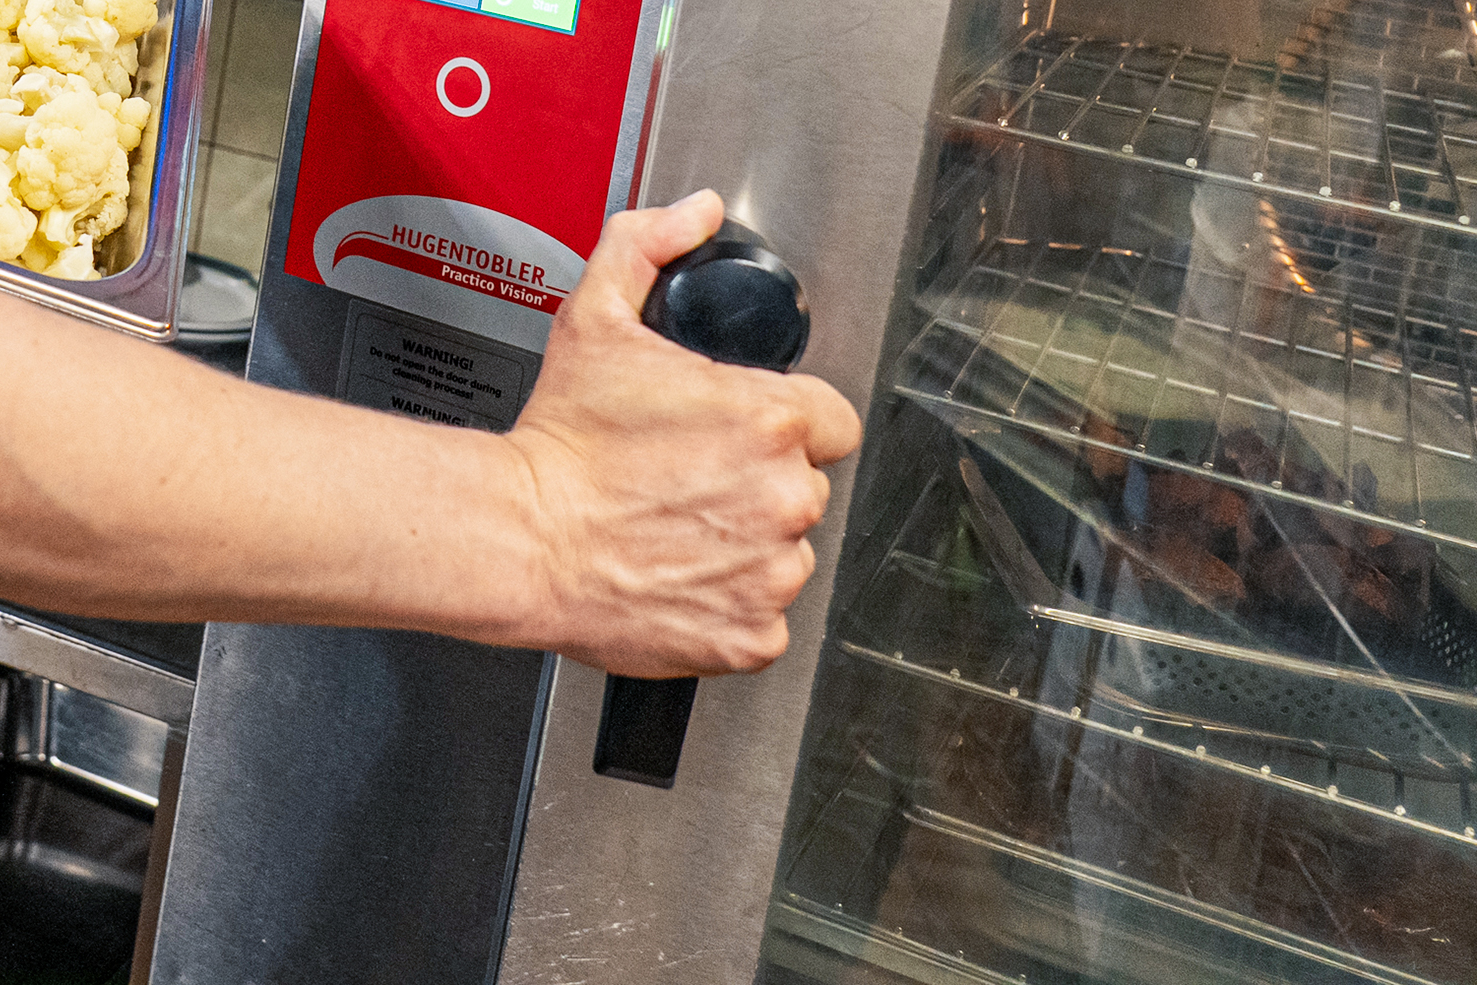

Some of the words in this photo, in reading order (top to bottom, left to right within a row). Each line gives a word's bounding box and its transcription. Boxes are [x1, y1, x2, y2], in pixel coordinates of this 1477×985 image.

[391, 224, 545, 286] HUGENTOBLER
[441, 265, 495, 292] Practico
[369, 346, 383, 358] Do
[384, 353, 401, 363] not
[402, 357, 426, 372] open
[428, 365, 444, 378] the
[445, 371, 469, 386] door
[470, 379, 502, 398] during
[402, 338, 474, 372] WARNING!
[392, 366, 432, 388] cleaning
[434, 381, 474, 400] process!
